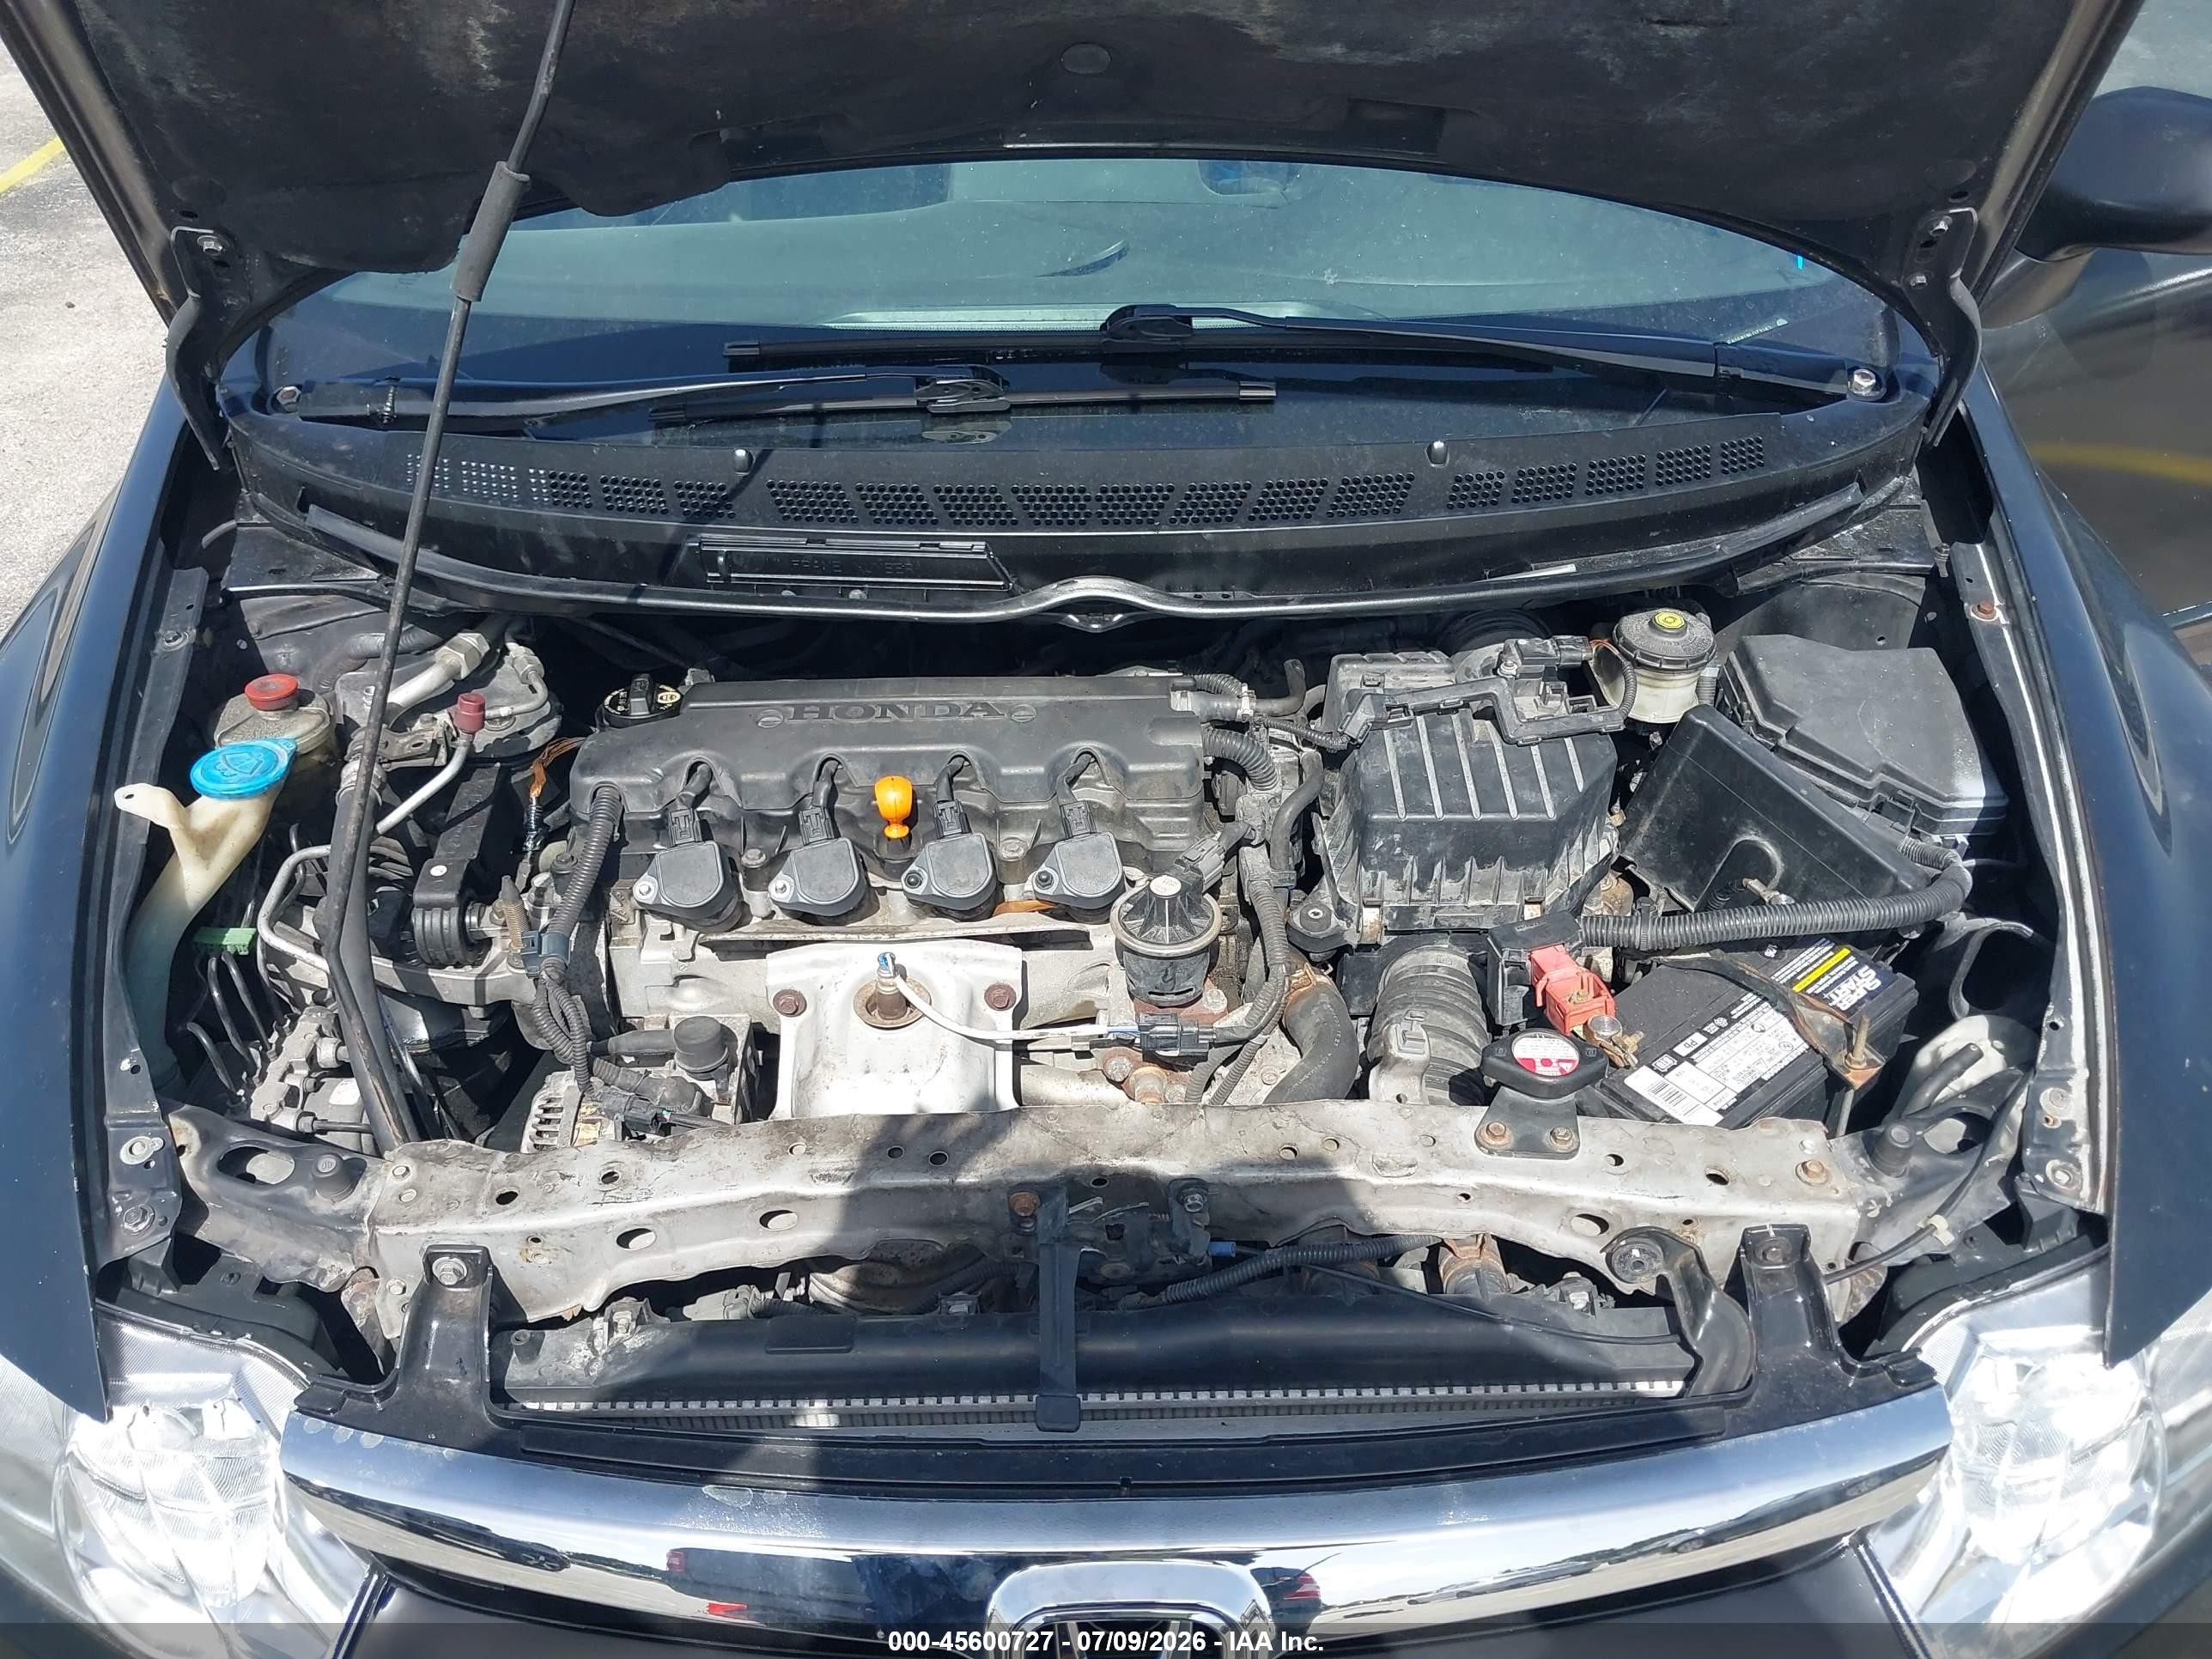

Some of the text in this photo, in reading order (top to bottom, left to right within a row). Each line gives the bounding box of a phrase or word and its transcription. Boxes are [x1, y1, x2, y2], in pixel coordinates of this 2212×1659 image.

[787, 702, 1006, 722] HONDA
[1827, 965, 1875, 1007] START
[1835, 977, 1881, 1011] SUPER
[1684, 1039, 1698, 1048] Pb
